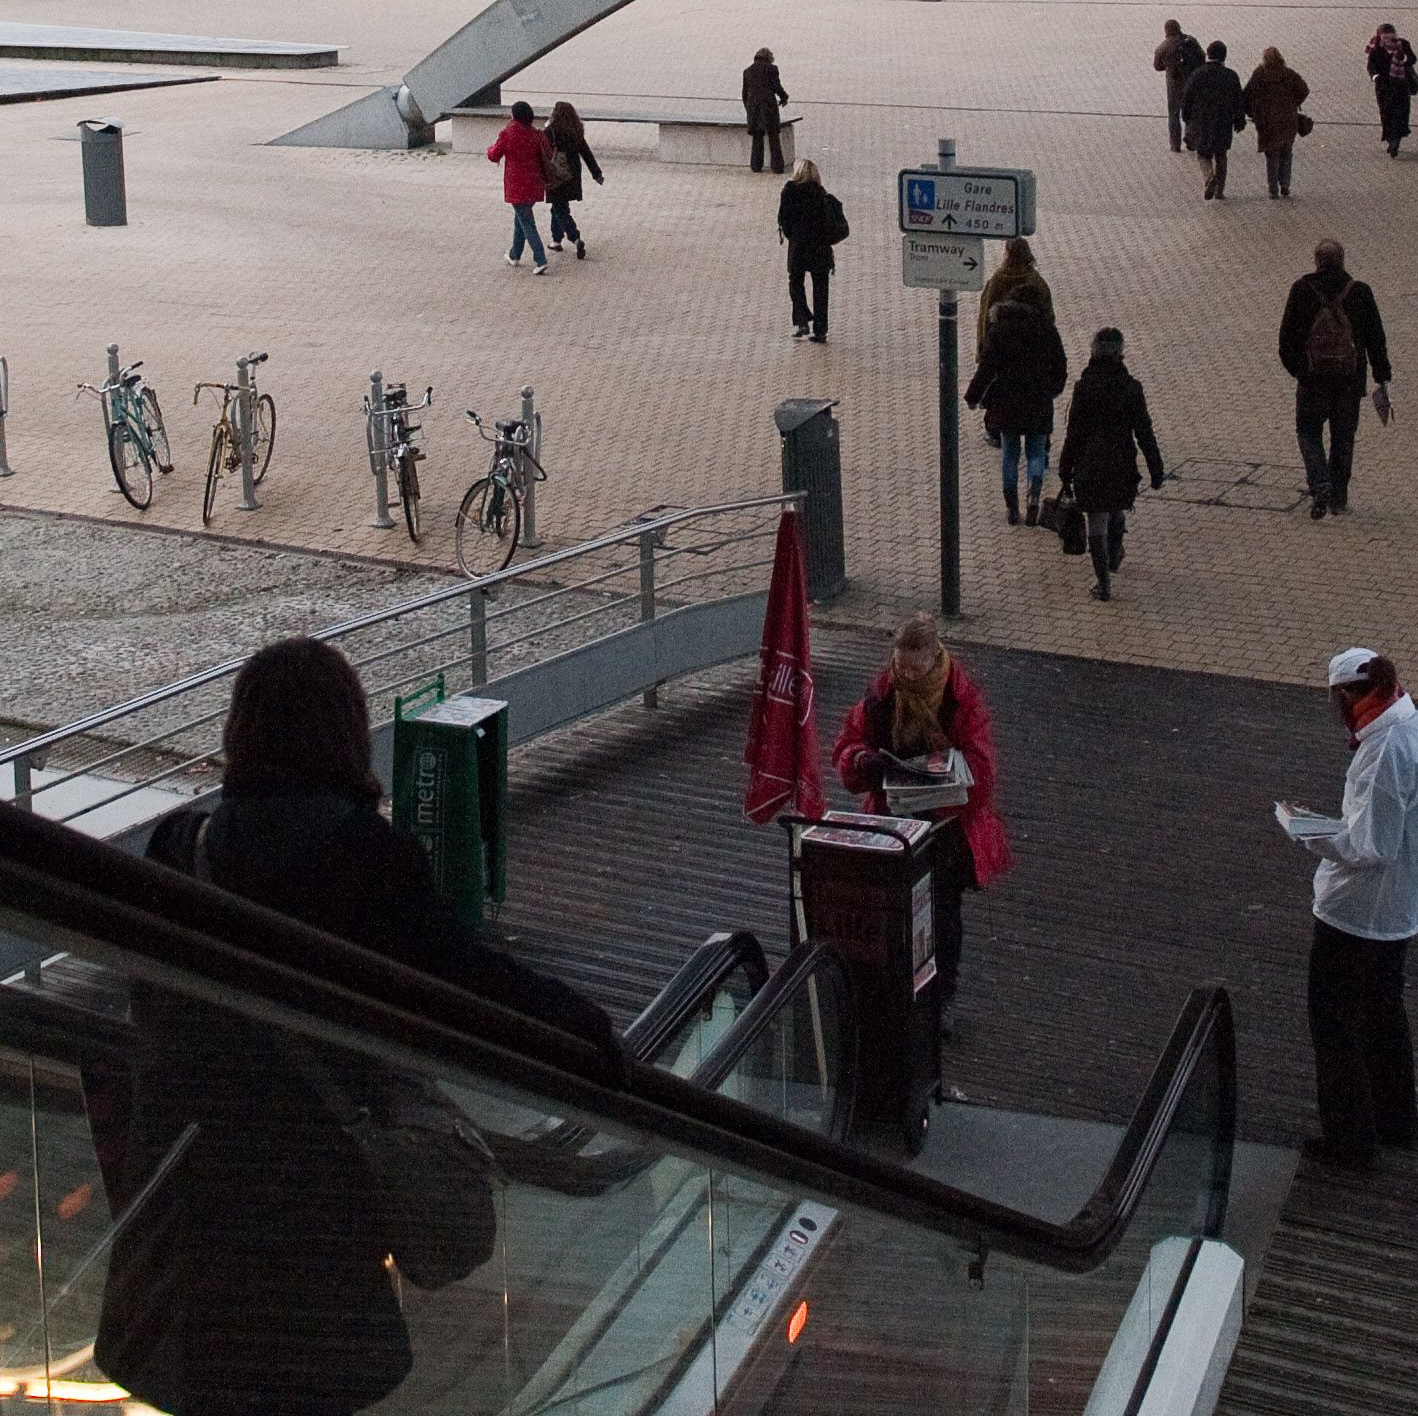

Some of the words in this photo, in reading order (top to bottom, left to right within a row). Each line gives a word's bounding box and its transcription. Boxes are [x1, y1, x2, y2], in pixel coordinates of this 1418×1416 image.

[964, 182, 992, 196] Gare
[936, 199, 960, 211] Lille
[964, 200, 1014, 214] Flandres
[966, 219, 989, 230] 450
[994, 222, 1004, 230] m
[909, 241, 965, 257] Tramway
[415, 751, 437, 824] metro
